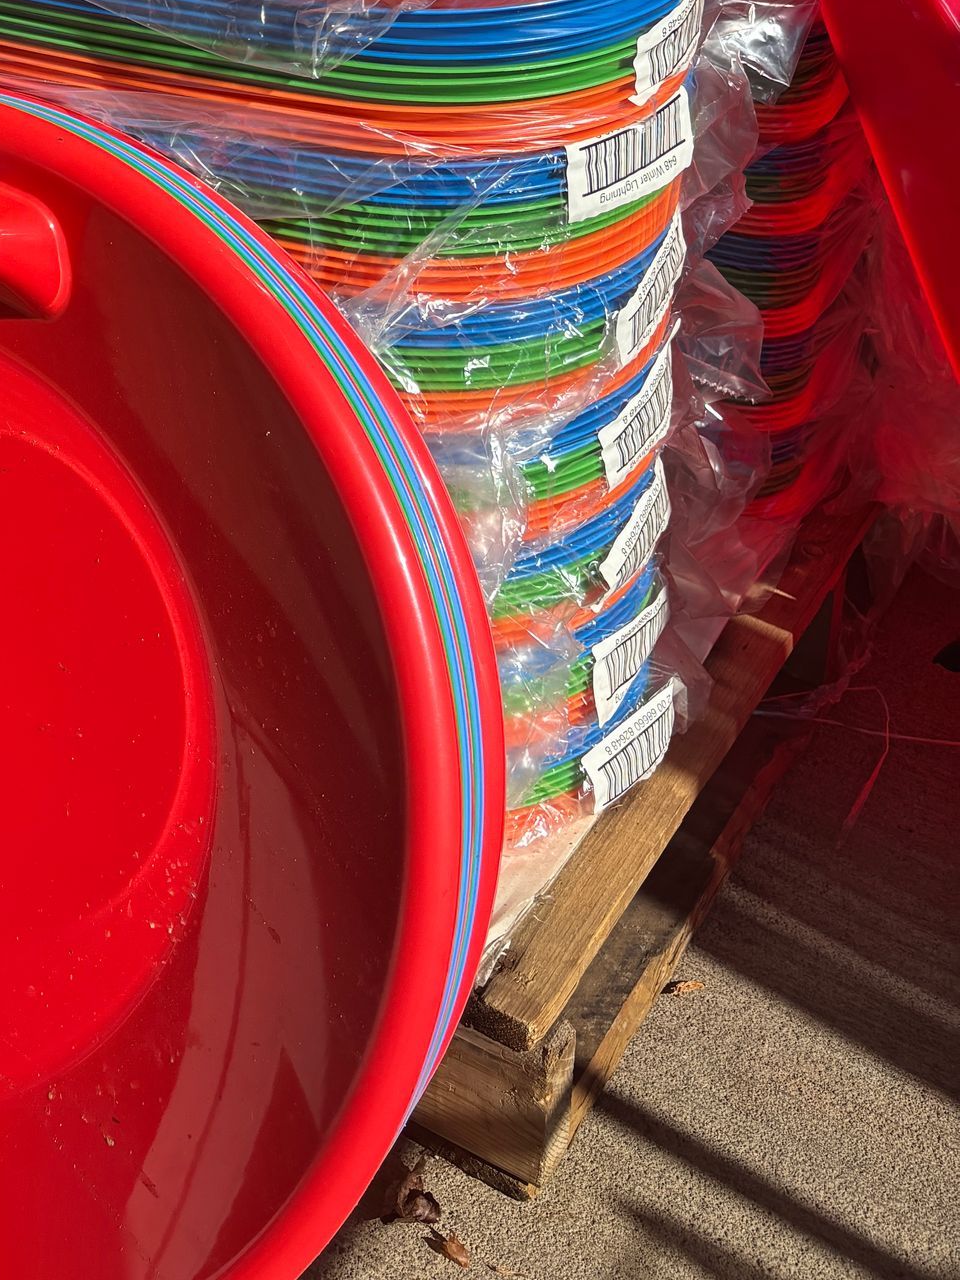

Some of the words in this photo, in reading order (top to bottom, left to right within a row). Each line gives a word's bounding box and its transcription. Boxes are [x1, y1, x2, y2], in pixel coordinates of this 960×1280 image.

[663, 155, 678, 171] 648
[640, 165, 664, 186] Winter
[599, 179, 639, 204] Lightning
[657, 701, 667, 712] 00
[634, 708, 657, 732] 68660
[611, 727, 635, 750] 82648
[604, 745, 613, 756] 8
